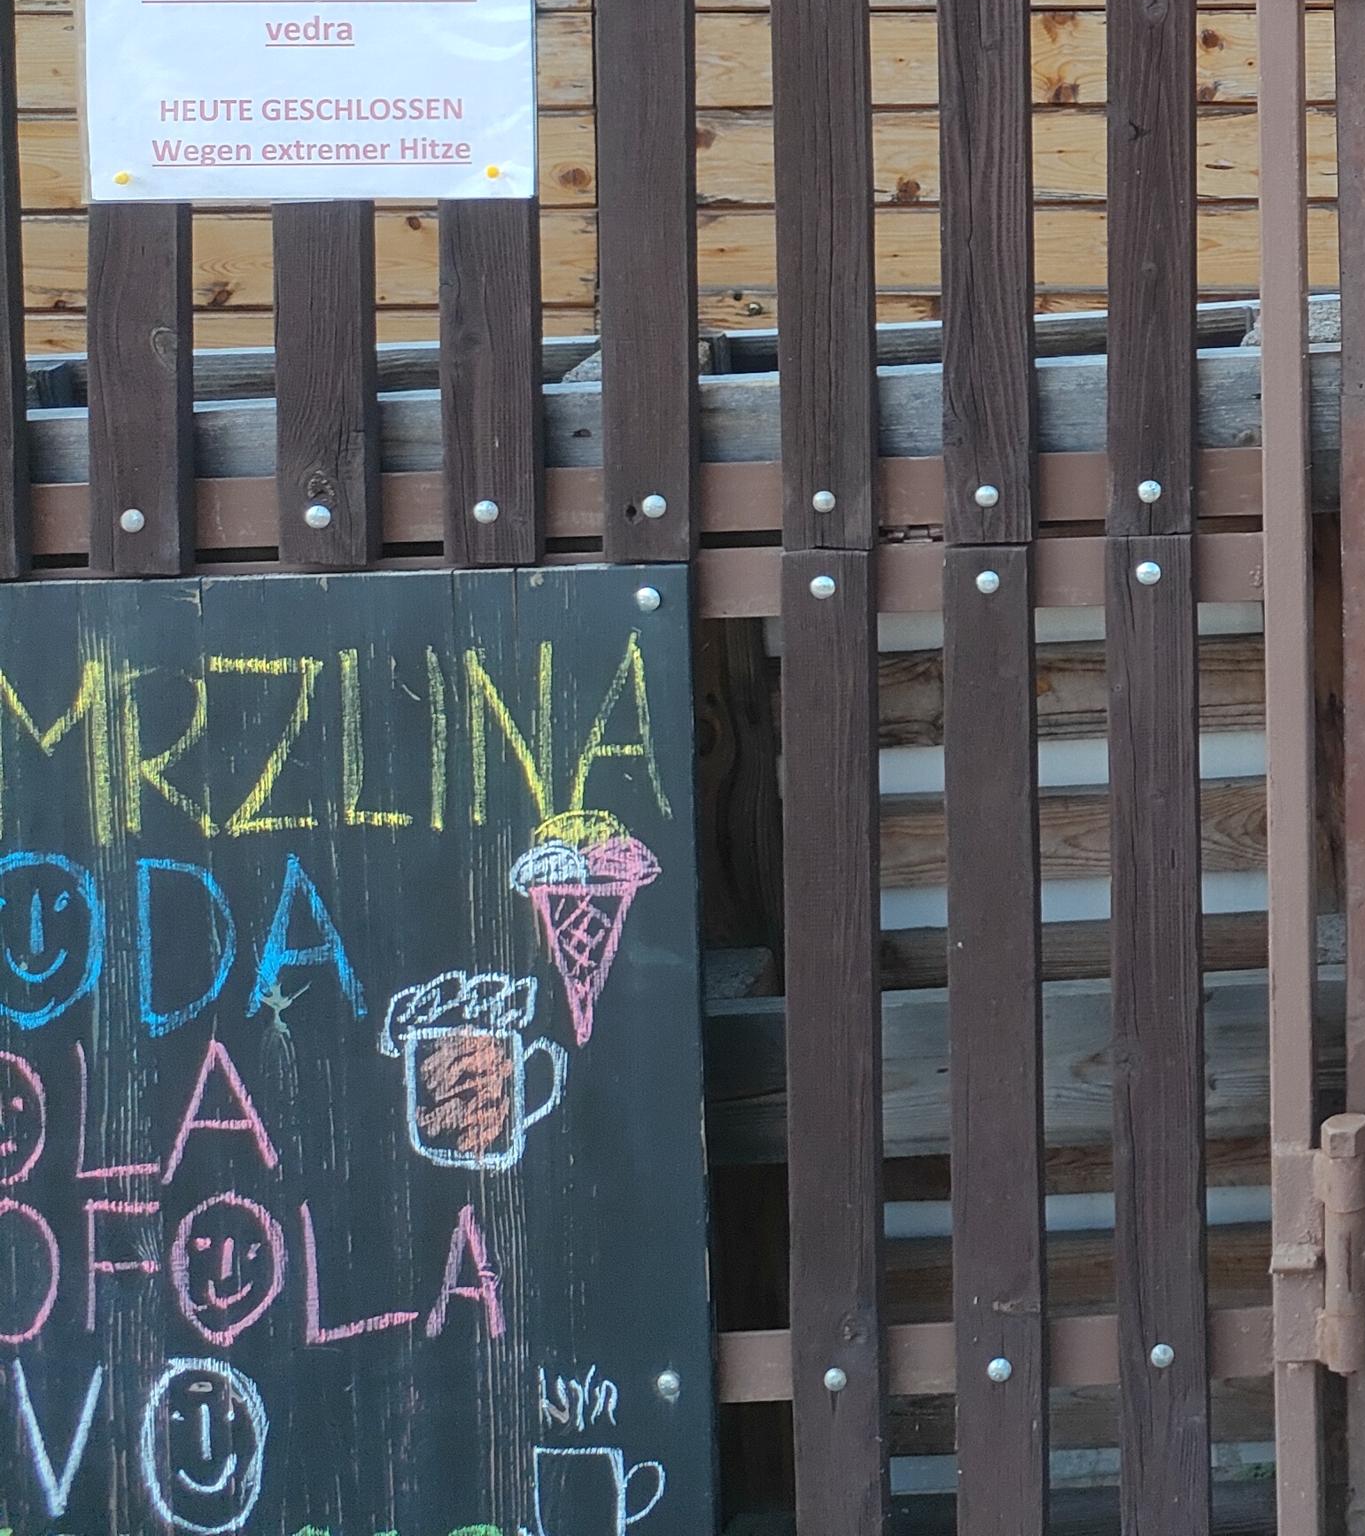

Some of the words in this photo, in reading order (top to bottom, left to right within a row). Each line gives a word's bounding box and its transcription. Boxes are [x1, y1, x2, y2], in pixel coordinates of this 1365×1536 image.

[266, 15, 353, 42] vedra
[160, 99, 252, 122] HEUTE
[262, 98, 462, 121] GESCHLOSSEN
[152, 140, 252, 166] Wegen
[261, 139, 389, 161] extremer
[400, 136, 472, 160] Hitze
